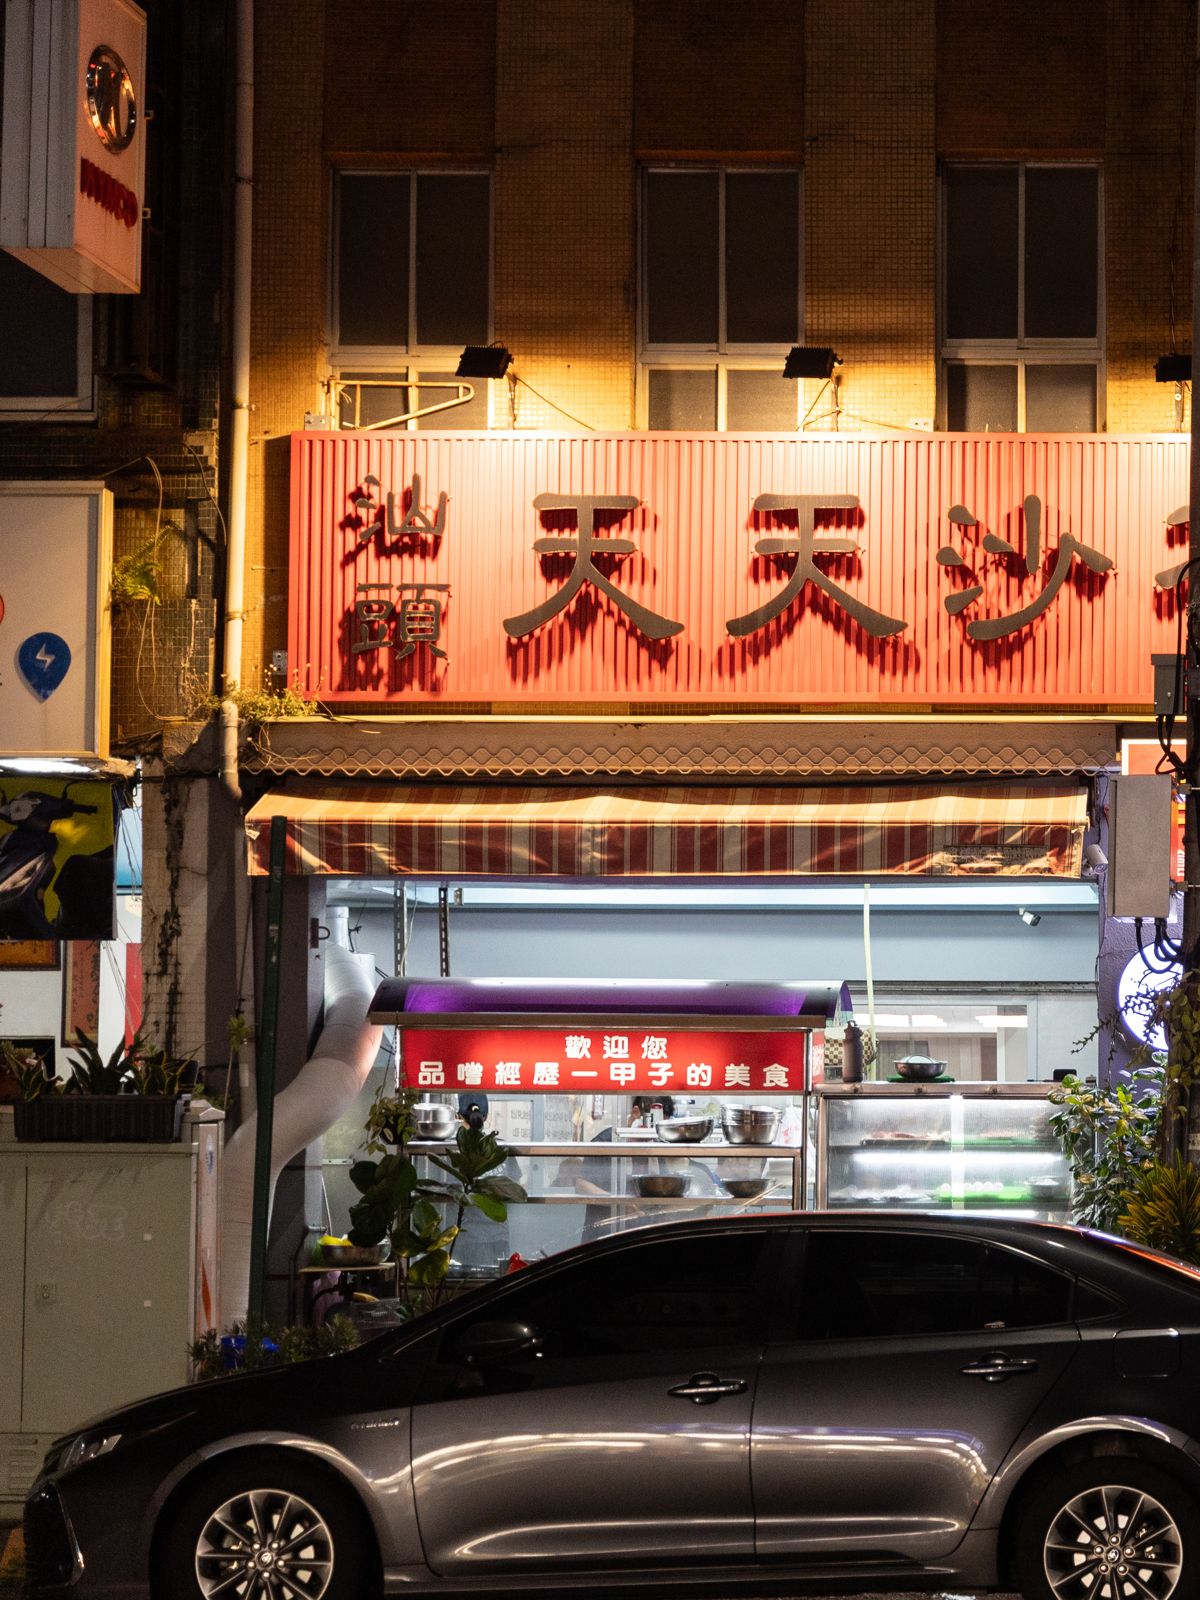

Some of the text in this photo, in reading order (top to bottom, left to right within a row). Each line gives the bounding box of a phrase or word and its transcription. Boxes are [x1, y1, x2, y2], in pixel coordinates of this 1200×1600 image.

[350, 472, 452, 661] 汕頭
[564, 1034, 669, 1060] 歡迎您
[417, 1061, 791, 1089] 品嚐經歷一甲子的美食
